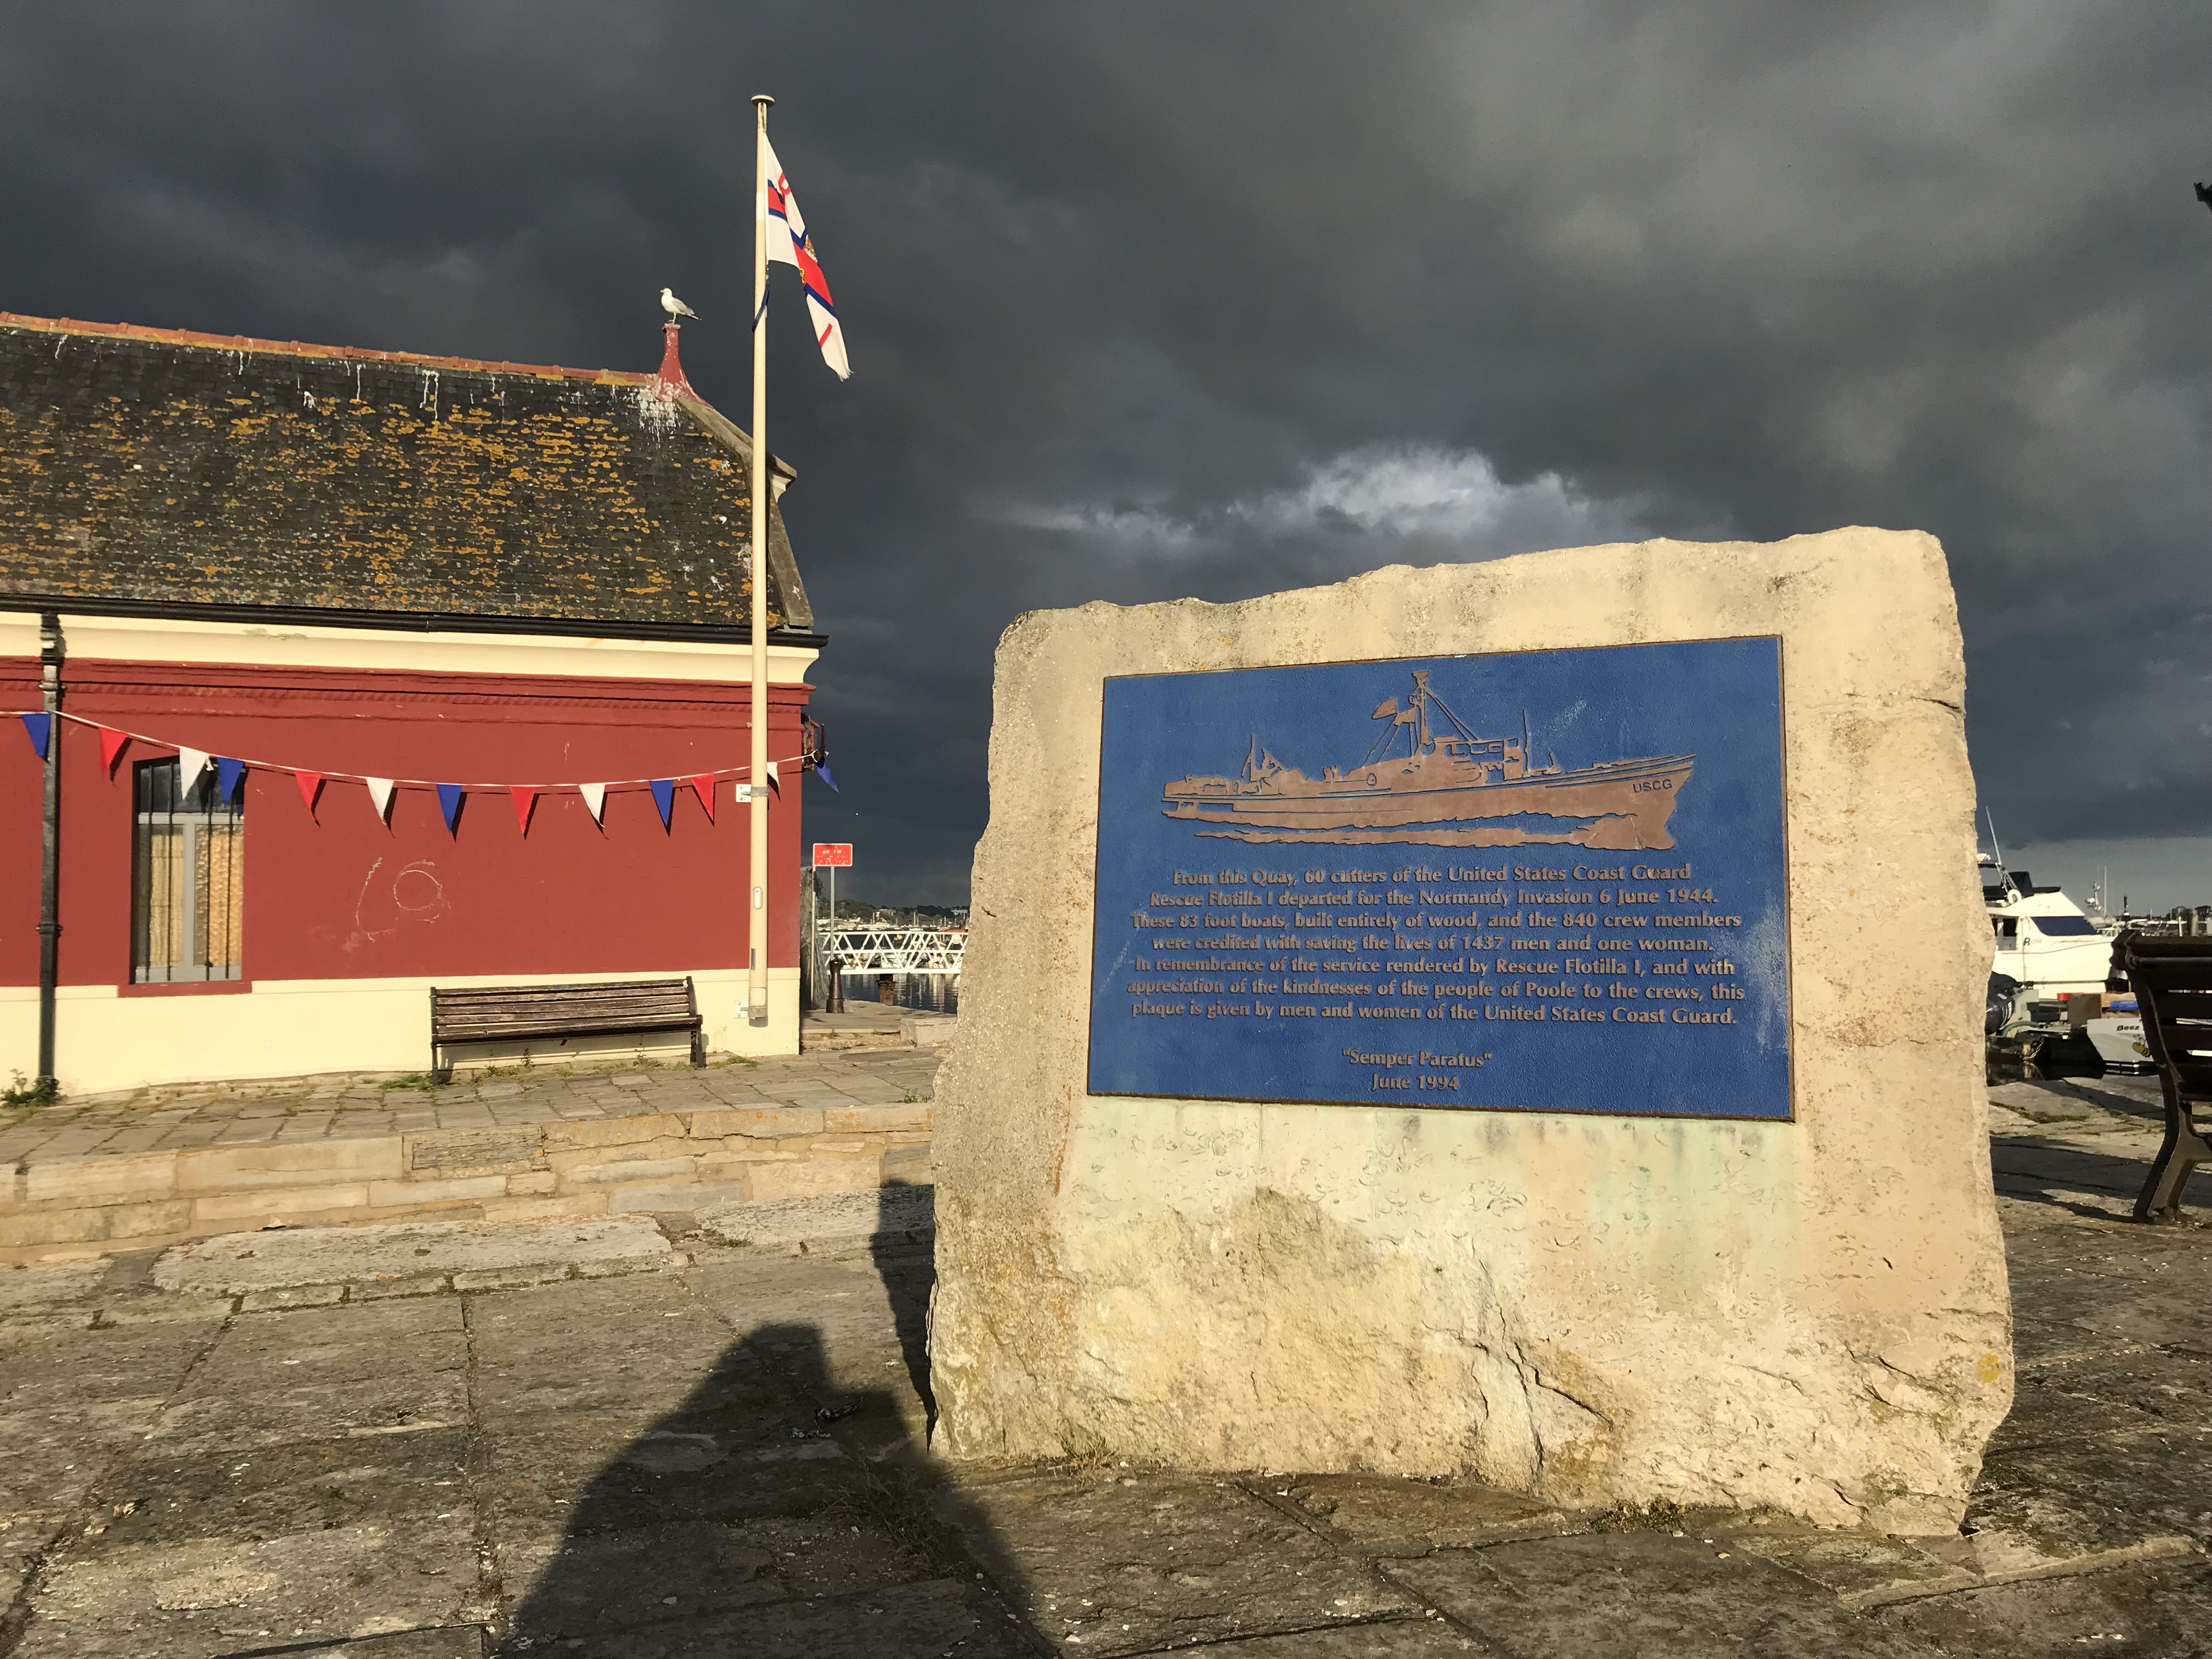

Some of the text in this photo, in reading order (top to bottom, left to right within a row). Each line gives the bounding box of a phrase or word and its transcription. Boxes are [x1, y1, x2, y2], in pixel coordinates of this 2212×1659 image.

[1632, 778, 1673, 793] USCG
[1173, 863, 1690, 887] From this Quay, 60 cutters of the United States Coast Guard
[1149, 888, 1717, 909] Rescue Flotilla I departed for the Normandy Invasion 6 June 1944.
[1130, 910, 1741, 930] These 83 foot boats, built entirely of wood, and the 840 crew members
[1152, 934, 1712, 953] were credited with saving the lives of 1437 men and one woman.
[1135, 956, 1735, 977] In remembrance of the service rendered by Rescue Flotilla I, and with
[1126, 978, 1745, 1001] appreciation of the kindnesses of the people of Poole to the crews, this
[1132, 999, 1736, 1024] plaque is given by men and women of the United States Coast Guard.
[1342, 1049, 1491, 1069] "Semper Paratus"
[1372, 1073, 1458, 1090] June 1994
